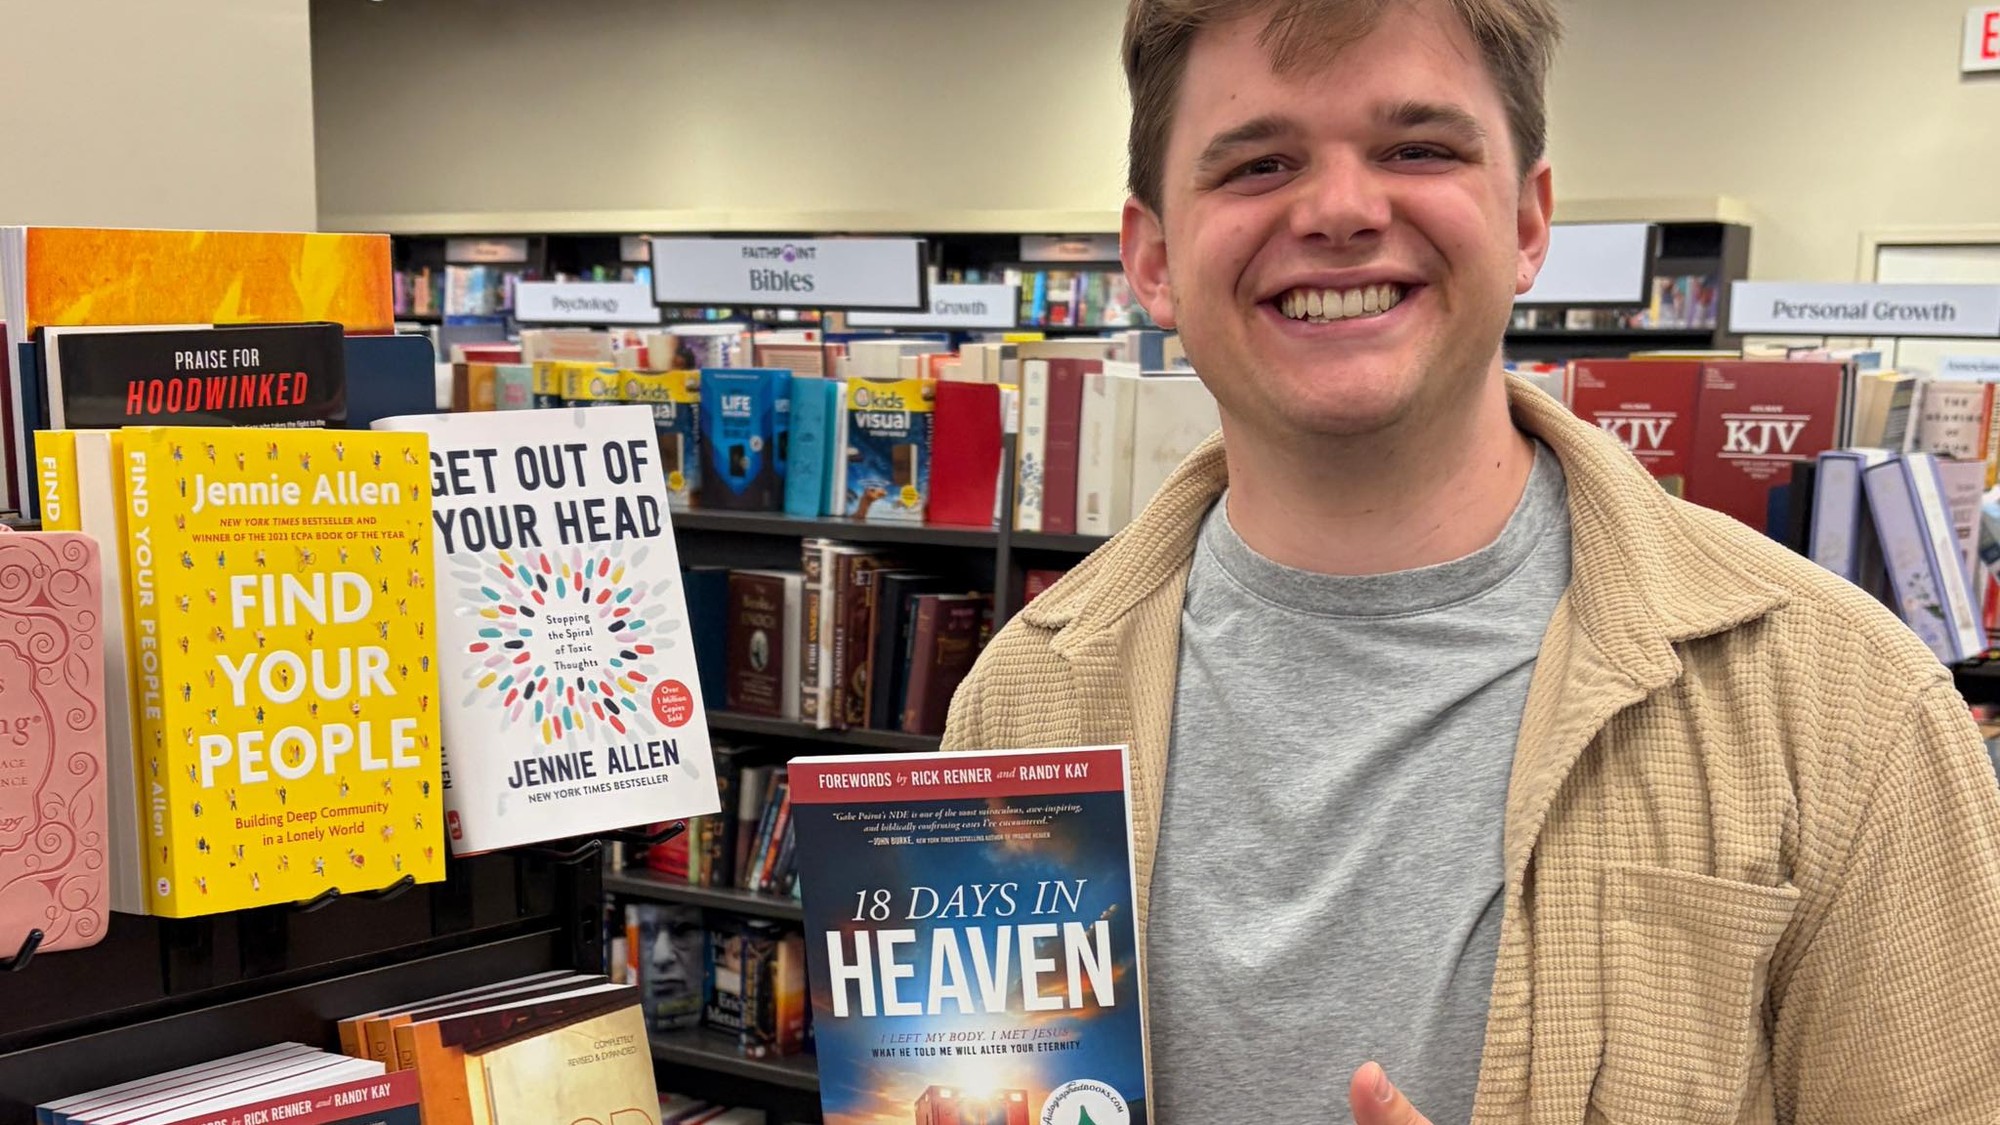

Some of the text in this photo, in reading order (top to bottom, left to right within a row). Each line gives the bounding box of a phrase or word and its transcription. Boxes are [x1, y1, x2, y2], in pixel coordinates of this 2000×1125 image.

[749, 268, 814, 292] Bibles
[552, 296, 619, 315] Psychology
[934, 299, 987, 316] Growth
[1772, 299, 1957, 322] Personal Growth
[175, 348, 260, 370] PRAISE FOR
[126, 372, 309, 415] HOODWINKED
[721, 395, 751, 411] LIFE
[871, 392, 904, 408] kids
[296, 420, 309, 428] fight
[855, 410, 911, 429] visual
[1722, 420, 1807, 455] KJV
[430, 440, 648, 497] GET OUT OF
[43, 456, 60, 522] FIND
[191, 471, 401, 514] Jennie Allen
[220, 516, 377, 527] NEW YORK TIMES BESTSELLER AND
[432, 495, 661, 554] YOUR HEAD
[192, 533, 230, 542] WINNER
[234, 533, 246, 542] OF
[249, 533, 266, 542] THE
[291, 532, 314, 541] ECPA
[316, 532, 343, 540] BOOK
[346, 531, 358, 540] OF
[361, 530, 379, 540] THE
[381, 530, 405, 540] YEAR
[230, 572, 373, 628] FIND
[546, 612, 591, 626] Stopping
[130, 451, 168, 837] FIND YOUR PEOPLE Allen
[548, 627, 594, 641] the Spiral
[555, 643, 593, 656] of Toxic
[554, 659, 599, 672] Thoughts
[215, 646, 398, 708] YOUR
[660, 686, 680, 694] Over
[662, 695, 688, 705] Million
[661, 704, 686, 715] Copies
[666, 714, 683, 723] Sold
[199, 717, 421, 789] PEOPLE
[508, 738, 680, 790] JENNIE ALLEN
[818, 762, 1089, 790] FOREWORDS by RICK RENNER and RANDY KAY
[528, 774, 669, 805] NEW YORK TIMES BESTSELLER
[235, 802, 389, 829] Building Deep Community
[888, 810, 910, 820] NDE
[912, 810, 918, 819] is
[919, 811, 933, 819] one
[935, 808, 944, 820] of
[945, 808, 957, 818] the
[959, 808, 978, 817] most
[979, 806, 1025, 816] miraculous,
[1026, 804, 1083, 815] awe-inspiring,
[263, 822, 365, 846] in a Lonely World
[864, 823, 880, 832] and
[881, 822, 917, 833] biblically
[918, 821, 961, 833] confirming
[983, 819, 998, 828] I've
[852, 878, 1088, 922] 18 DAYS IN
[825, 920, 1116, 1018] HEAVEN
[594, 1034, 634, 1050] COMPLETELY
[881, 1035, 886, 1044] I
[890, 1033, 922, 1044] LEFT
[926, 1032, 946, 1043] MY
[949, 1031, 986, 1042] BODY.
[991, 1031, 996, 1041] I
[1000, 1030, 1028, 1041] MET
[568, 1054, 595, 1067] REVISED
[602, 1046, 638, 1061] EXPANDED
[872, 1048, 896, 1058] WHAT
[900, 1048, 911, 1057] HE
[914, 1047, 936, 1057] TOLD
[940, 1046, 952, 1056] ME
[955, 1046, 976, 1056] WILL
[980, 1045, 1008, 1055] ALTER
[1010, 1044, 1034, 1054] YOUR
[244, 1110, 269, 1125] RICK
[271, 1100, 313, 1120] RENNER
[315, 1096, 333, 1109] and
[334, 1088, 369, 1108] RANDY
[371, 1082, 392, 1099] KAY
